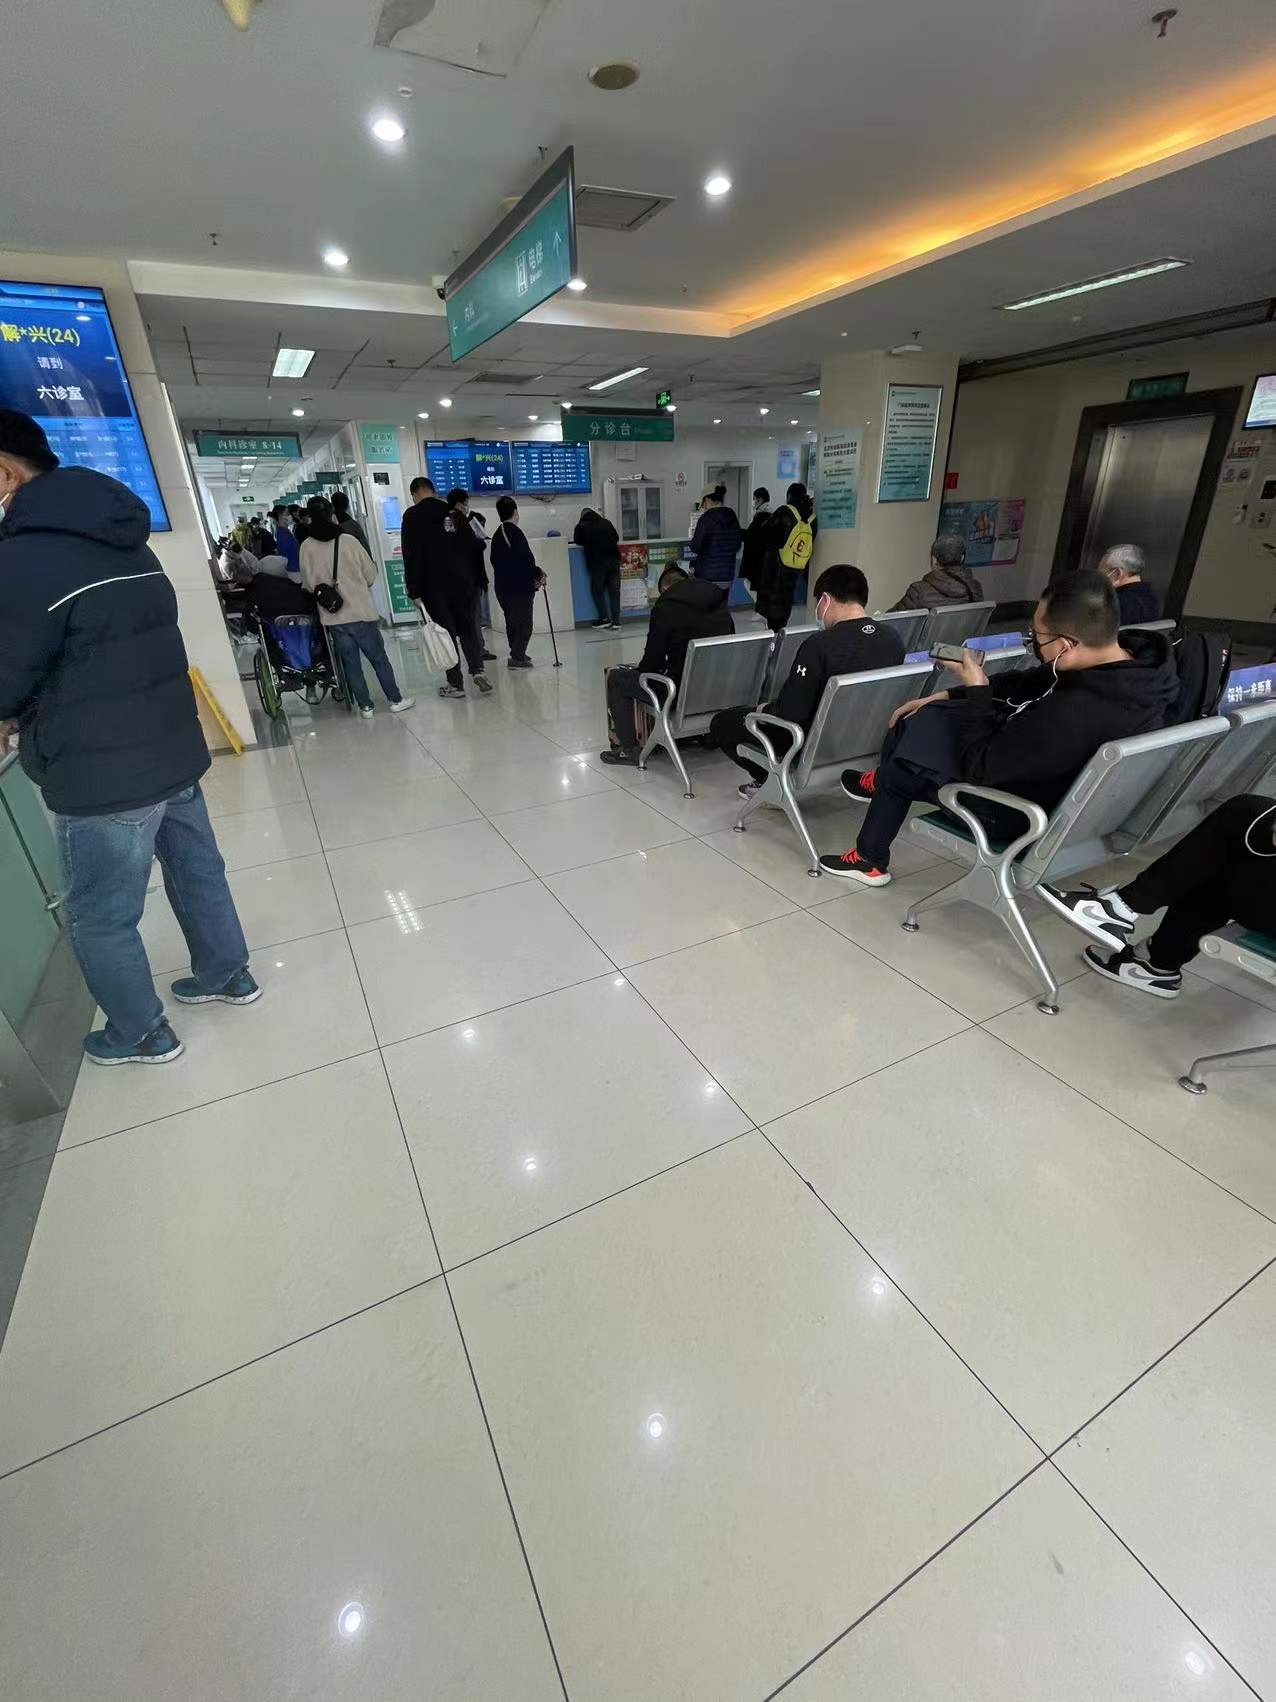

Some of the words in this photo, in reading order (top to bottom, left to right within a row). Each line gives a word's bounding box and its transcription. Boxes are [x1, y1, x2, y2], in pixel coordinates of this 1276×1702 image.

[37, 385, 84, 401] 六诊室
[590, 421, 631, 436] 分诊台
[217, 439, 257, 450] 内科诊室
[480, 475, 504, 485] 六诊室
